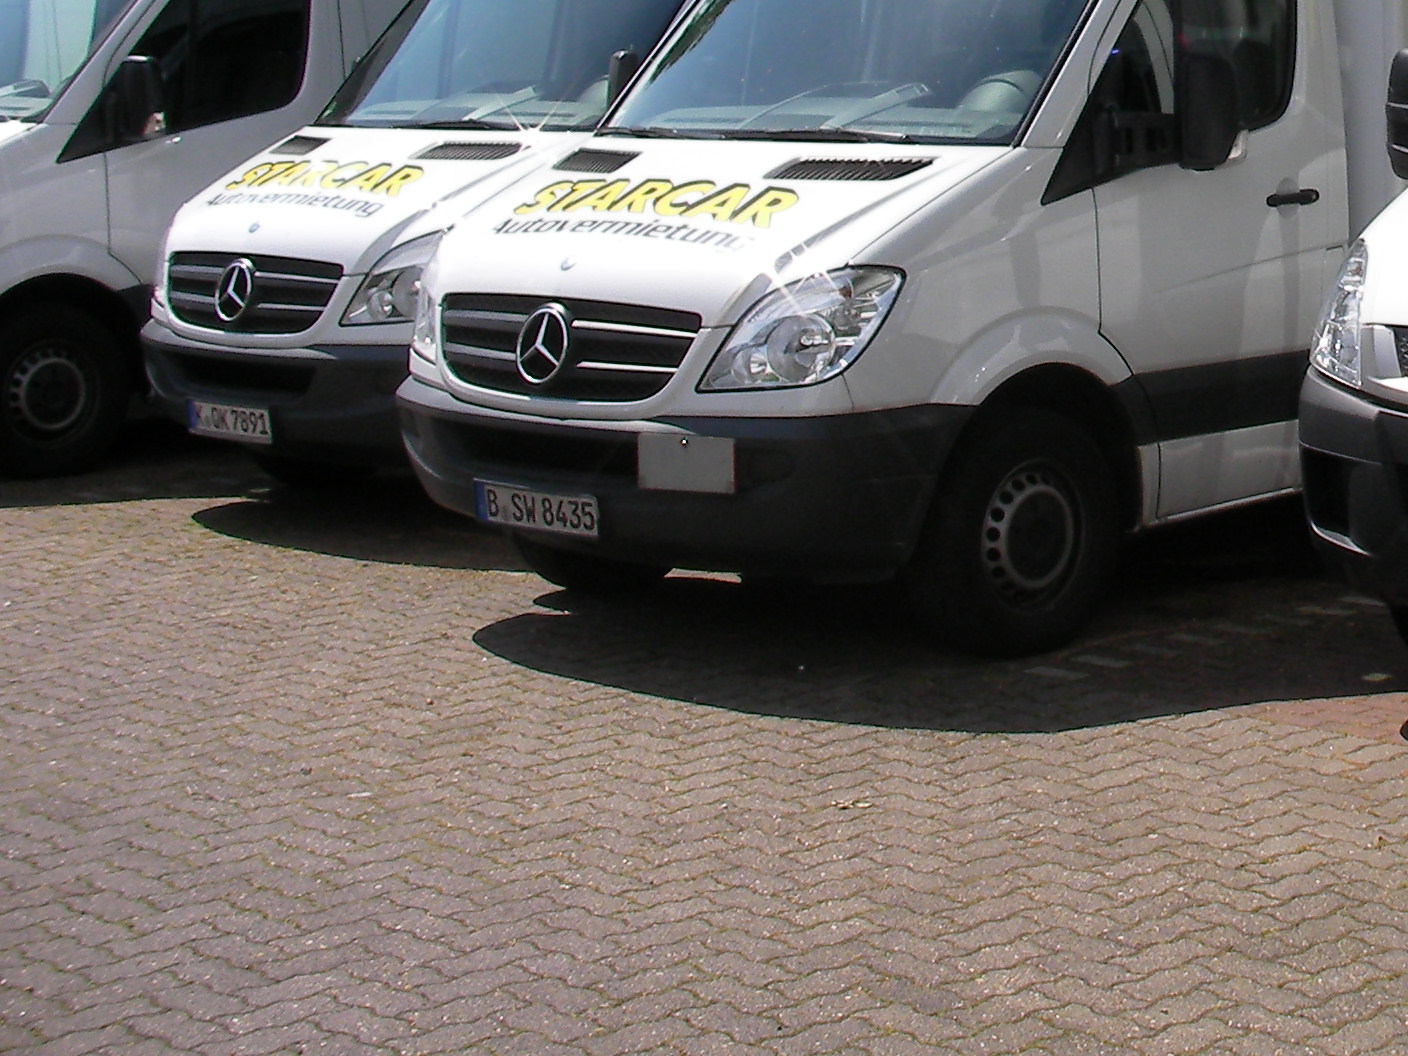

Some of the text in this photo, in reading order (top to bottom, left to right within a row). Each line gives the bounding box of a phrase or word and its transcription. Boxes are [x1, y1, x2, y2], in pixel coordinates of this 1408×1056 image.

[225, 160, 424, 197] STARCAR
[206, 190, 383, 218] Autovermietung
[513, 178, 799, 229] STARCAR
[231, 409, 269, 435] 7891
[487, 489, 595, 530] B SW 8435
